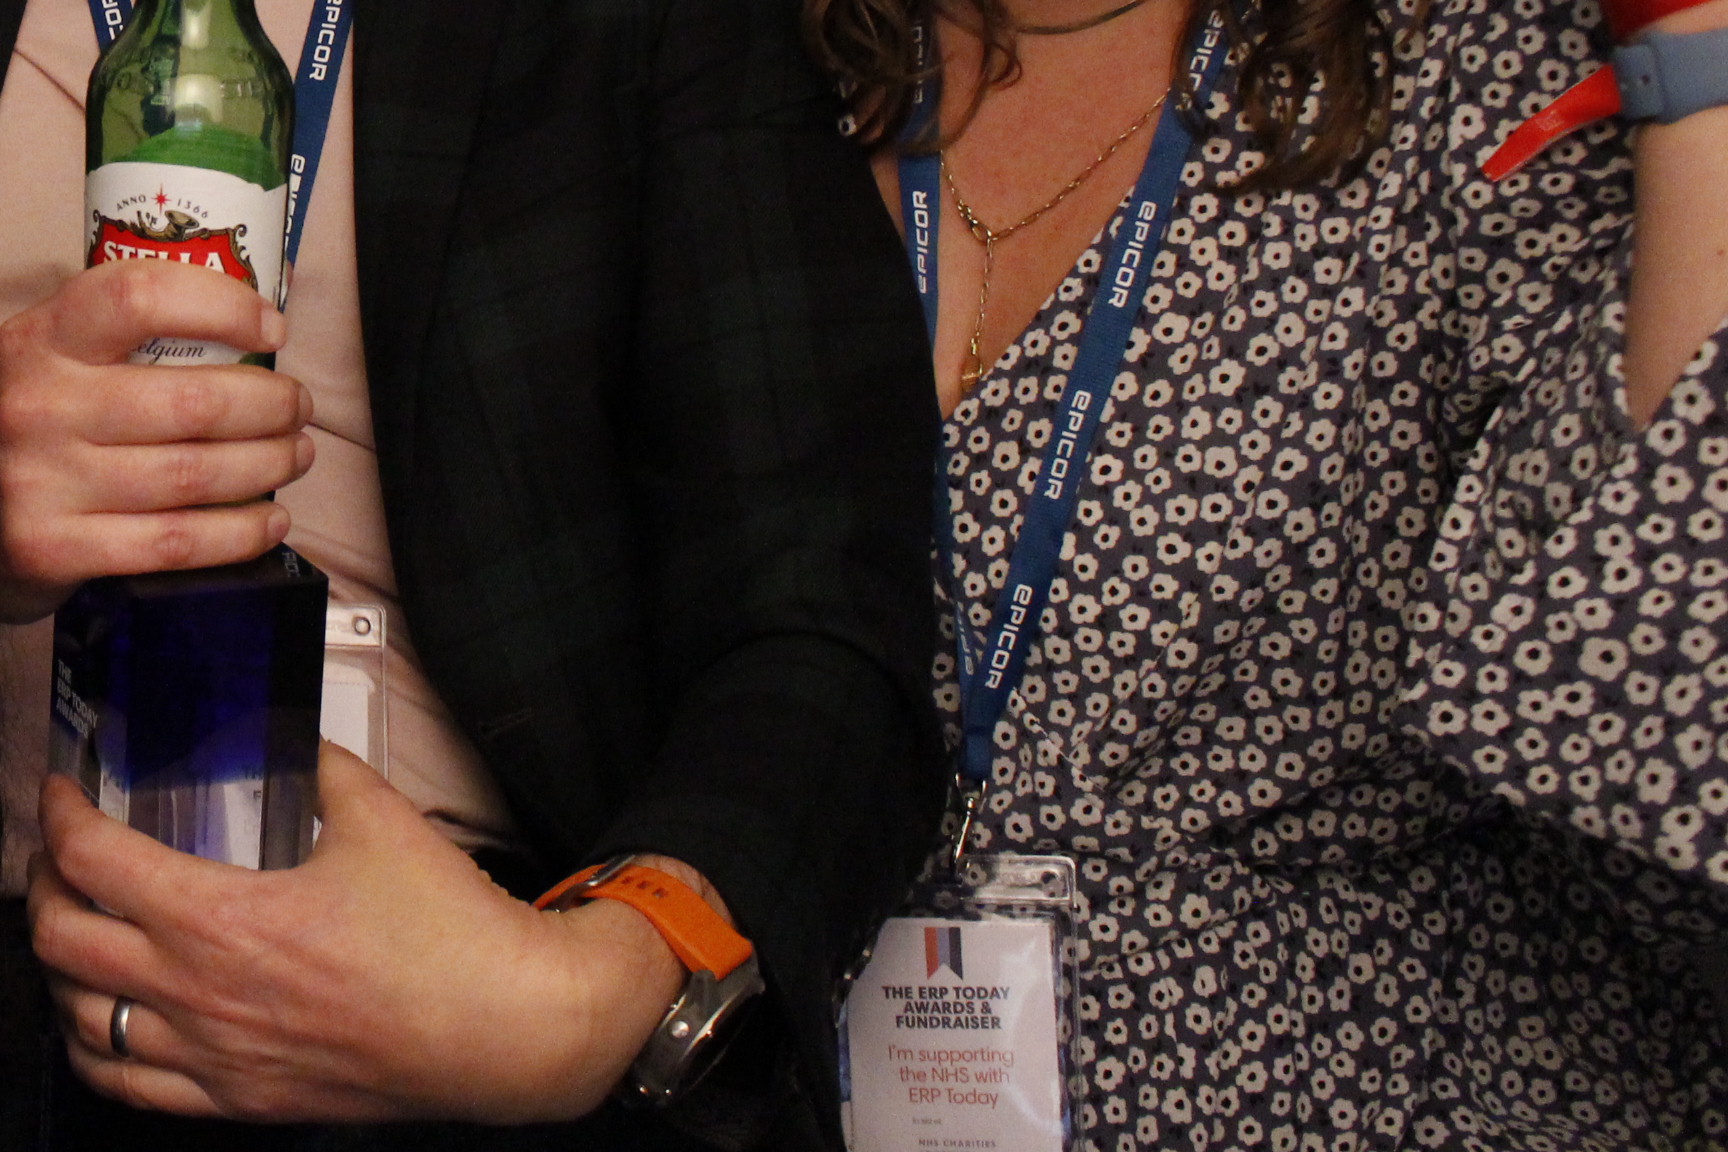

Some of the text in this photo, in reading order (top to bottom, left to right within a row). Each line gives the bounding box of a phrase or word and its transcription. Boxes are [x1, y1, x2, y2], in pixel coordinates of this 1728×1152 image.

[116, 194, 209, 219] ANNO 1366
[136, 337, 207, 365] elgium
[57, 658, 72, 685] THE
[56, 696, 89, 740] AWARDS
[71, 691, 98, 729] TODAY
[882, 986, 1010, 1000] THE ERP TODAY
[904, 1001, 992, 1015] AWARDS &
[895, 1015, 1002, 1030] FUNDRAISER
[888, 1044, 1014, 1068] I'm supporting
[899, 1065, 1010, 1084] the NHS with
[909, 1087, 999, 1110] ERP Today
[918, 1138, 997, 1148] NHS CHARITIES
